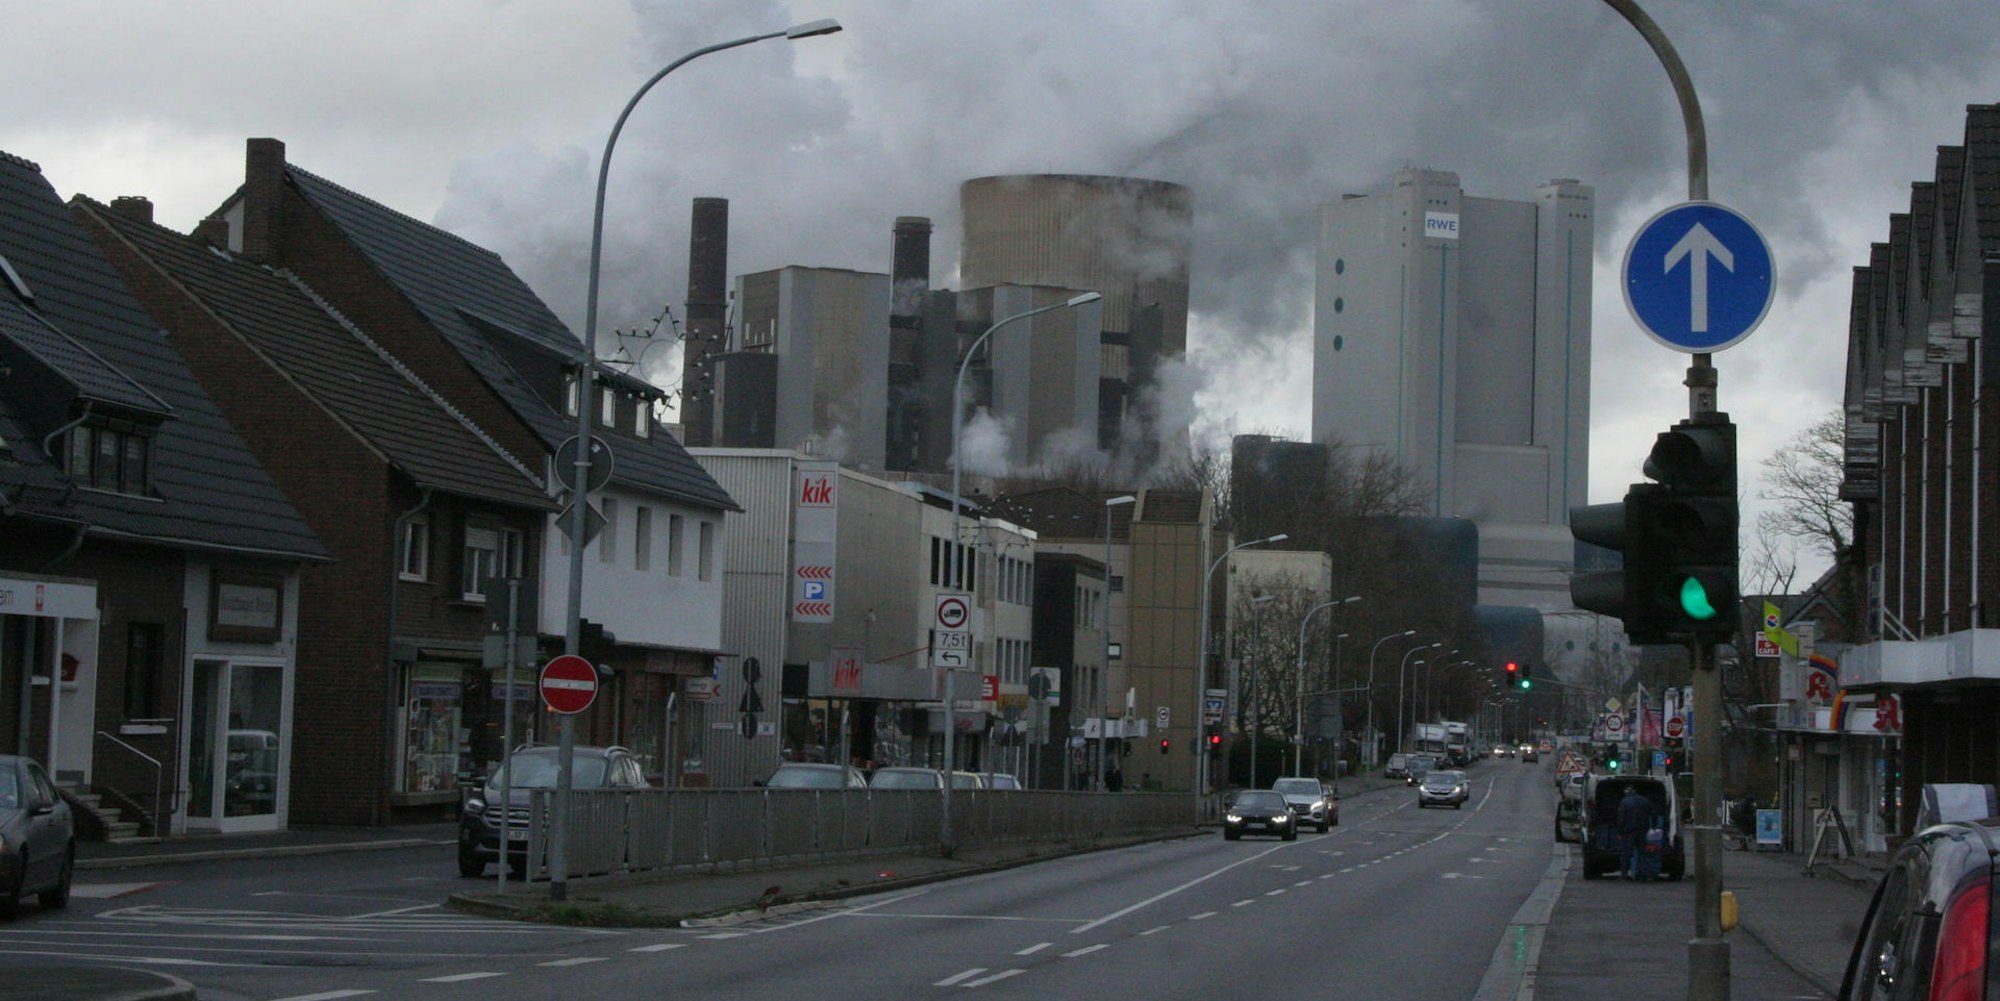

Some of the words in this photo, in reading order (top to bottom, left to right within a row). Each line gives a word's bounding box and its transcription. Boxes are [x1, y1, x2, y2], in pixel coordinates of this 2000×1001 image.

[1427, 219, 1456, 231] RWE
[802, 477, 832, 503] kik
[1668, 723, 1682, 731] STOP
